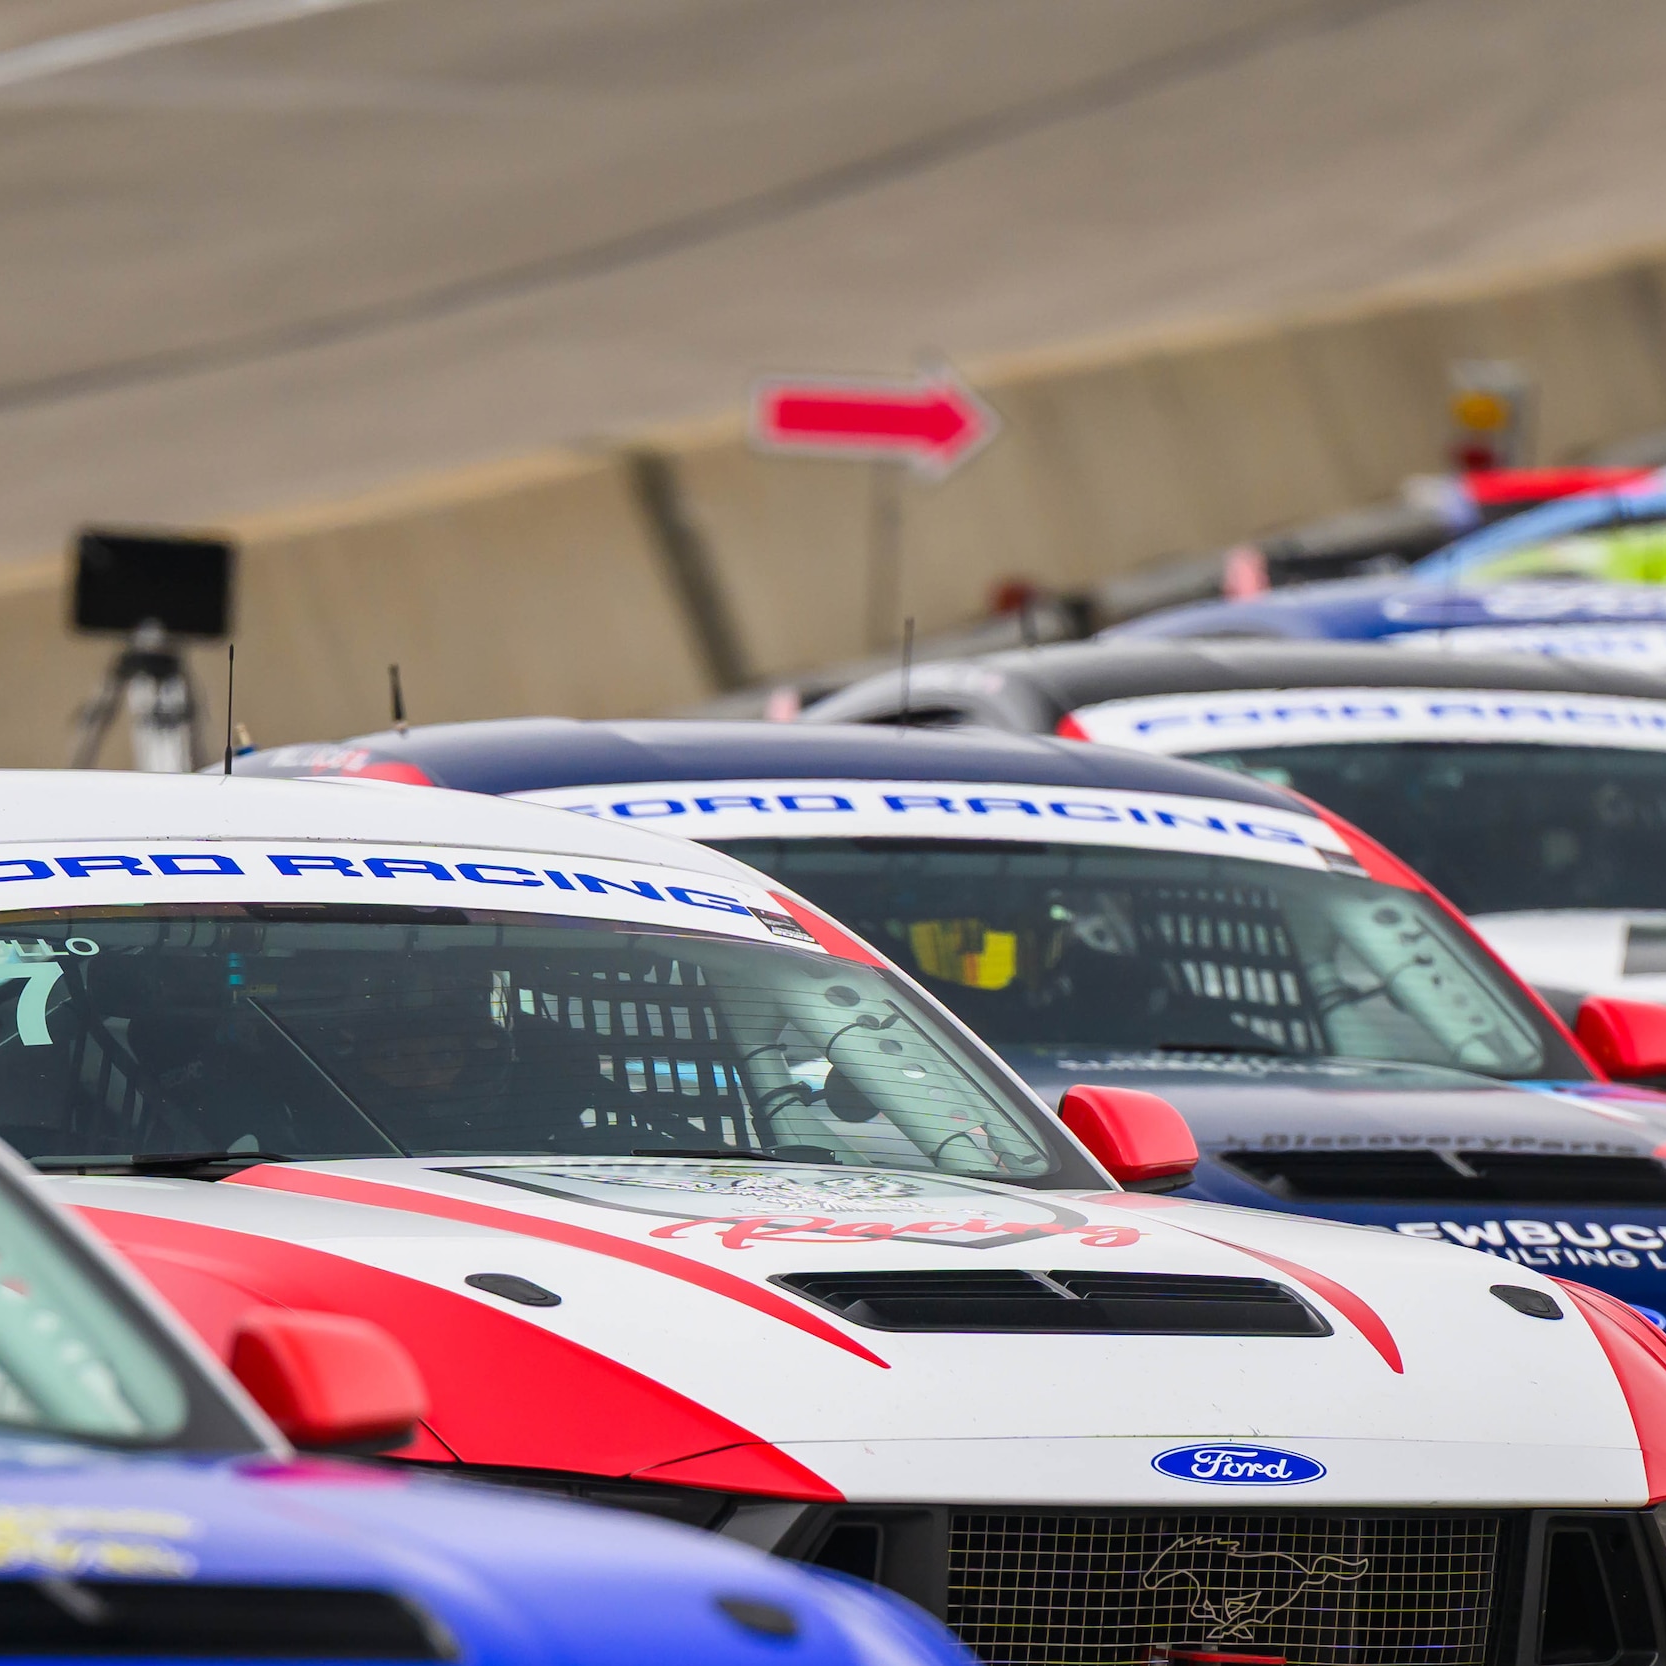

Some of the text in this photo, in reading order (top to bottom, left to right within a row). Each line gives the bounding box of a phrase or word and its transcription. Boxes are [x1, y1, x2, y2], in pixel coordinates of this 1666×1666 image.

[879, 795, 1308, 848] RACING
[266, 855, 754, 917] RACING
[648, 1214, 1149, 1250] Racing
[1190, 1448, 1293, 1481] Ford
